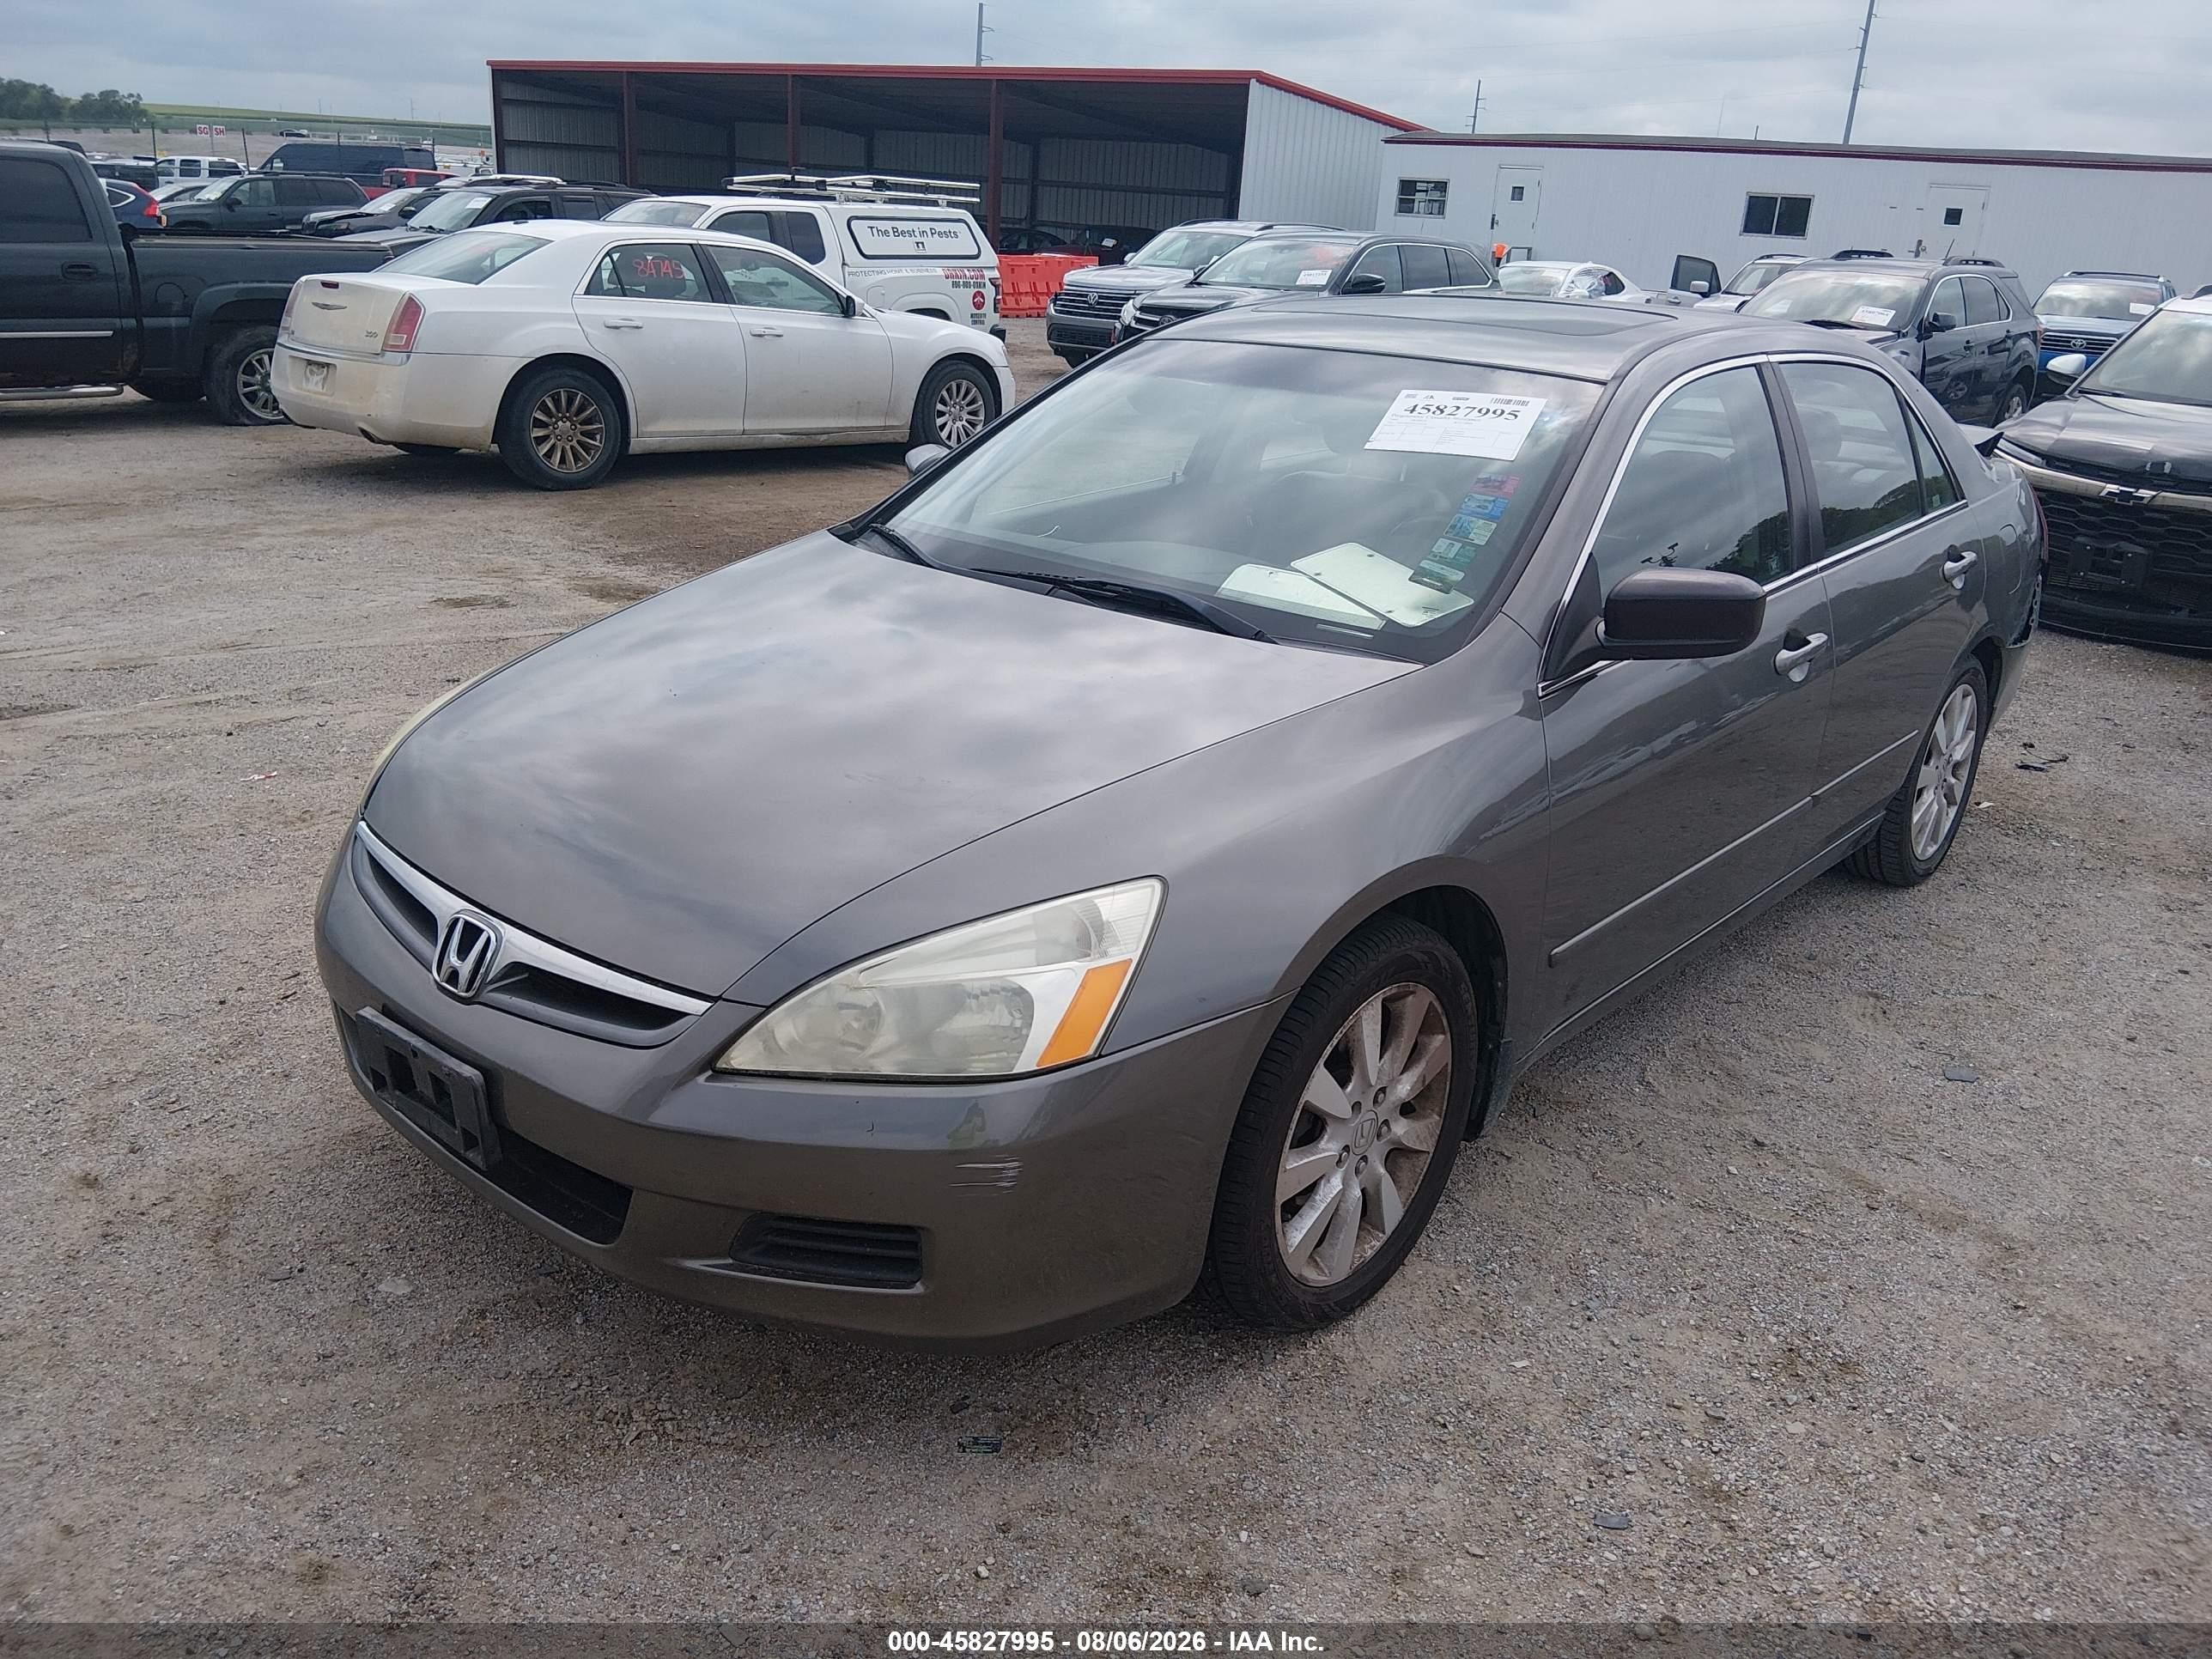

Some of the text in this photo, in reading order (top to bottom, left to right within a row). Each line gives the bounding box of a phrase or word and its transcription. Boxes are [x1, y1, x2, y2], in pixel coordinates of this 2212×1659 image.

[198, 126, 209, 136] SG
[214, 127, 225, 137] SH
[867, 226, 958, 239] The Best in Pests
[1404, 404, 1521, 421] 45827995
